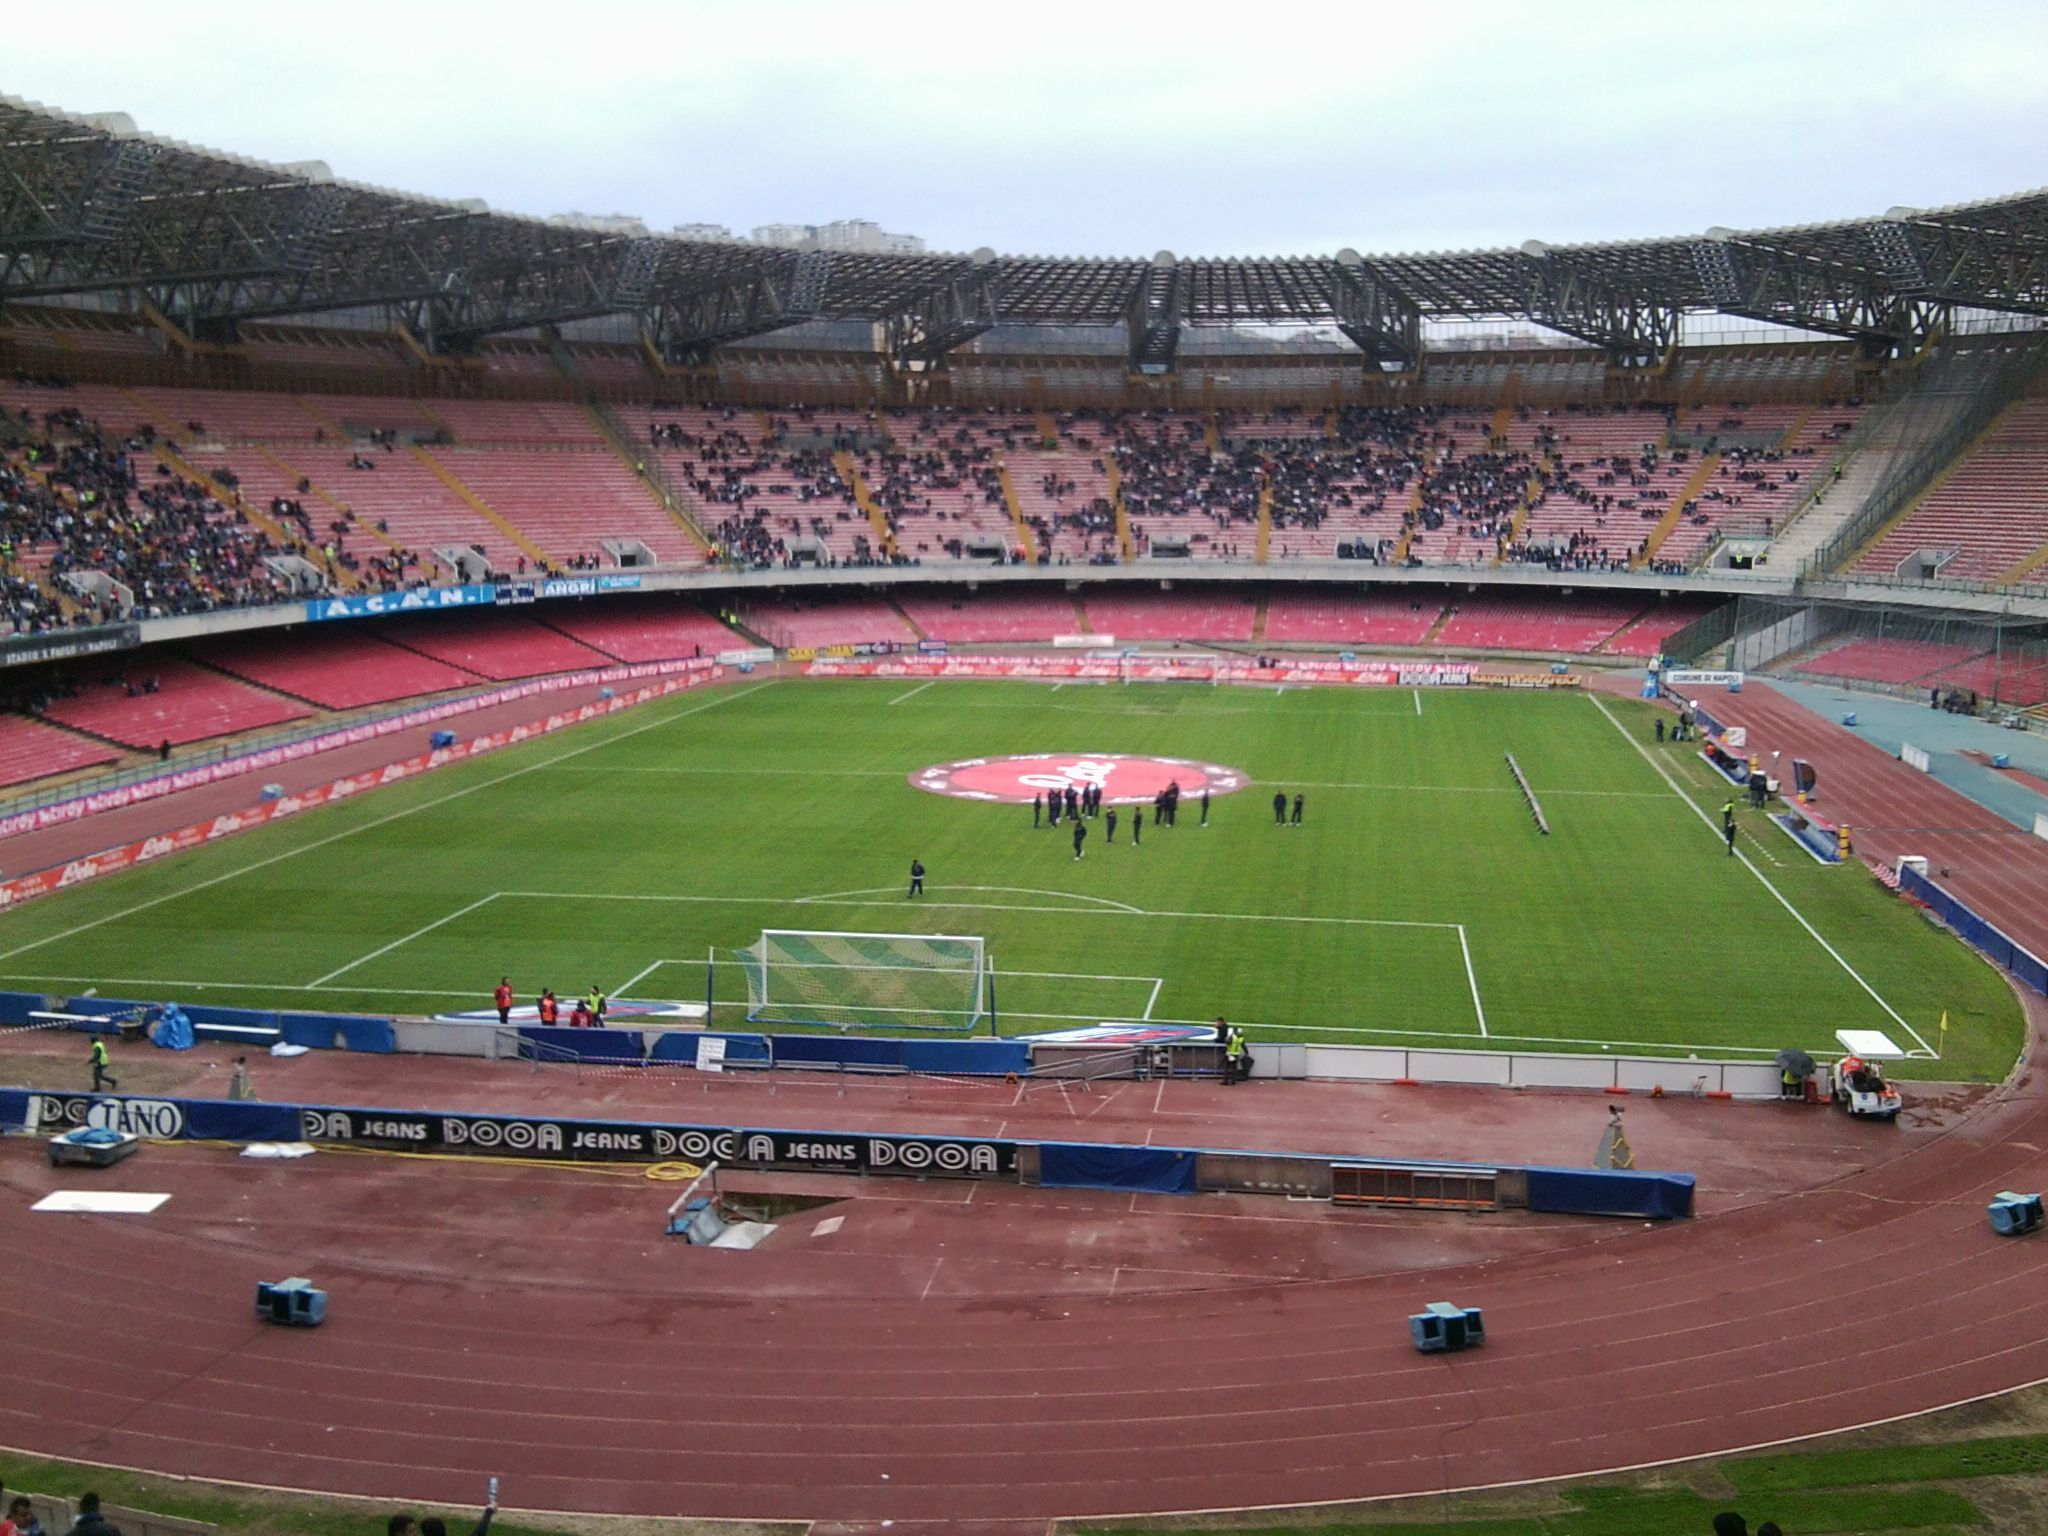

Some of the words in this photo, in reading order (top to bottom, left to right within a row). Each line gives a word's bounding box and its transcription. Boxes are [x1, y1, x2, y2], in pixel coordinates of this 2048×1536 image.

[1673, 674, 1701, 682] COMUNE
[1704, 674, 1712, 682] DI
[362, 1120, 428, 1140] JEANS
[443, 1117, 562, 1151] DOOA
[572, 1131, 642, 1151] JEANS
[786, 1143, 856, 1162] JEANS
[870, 1139, 997, 1171] DOOA
